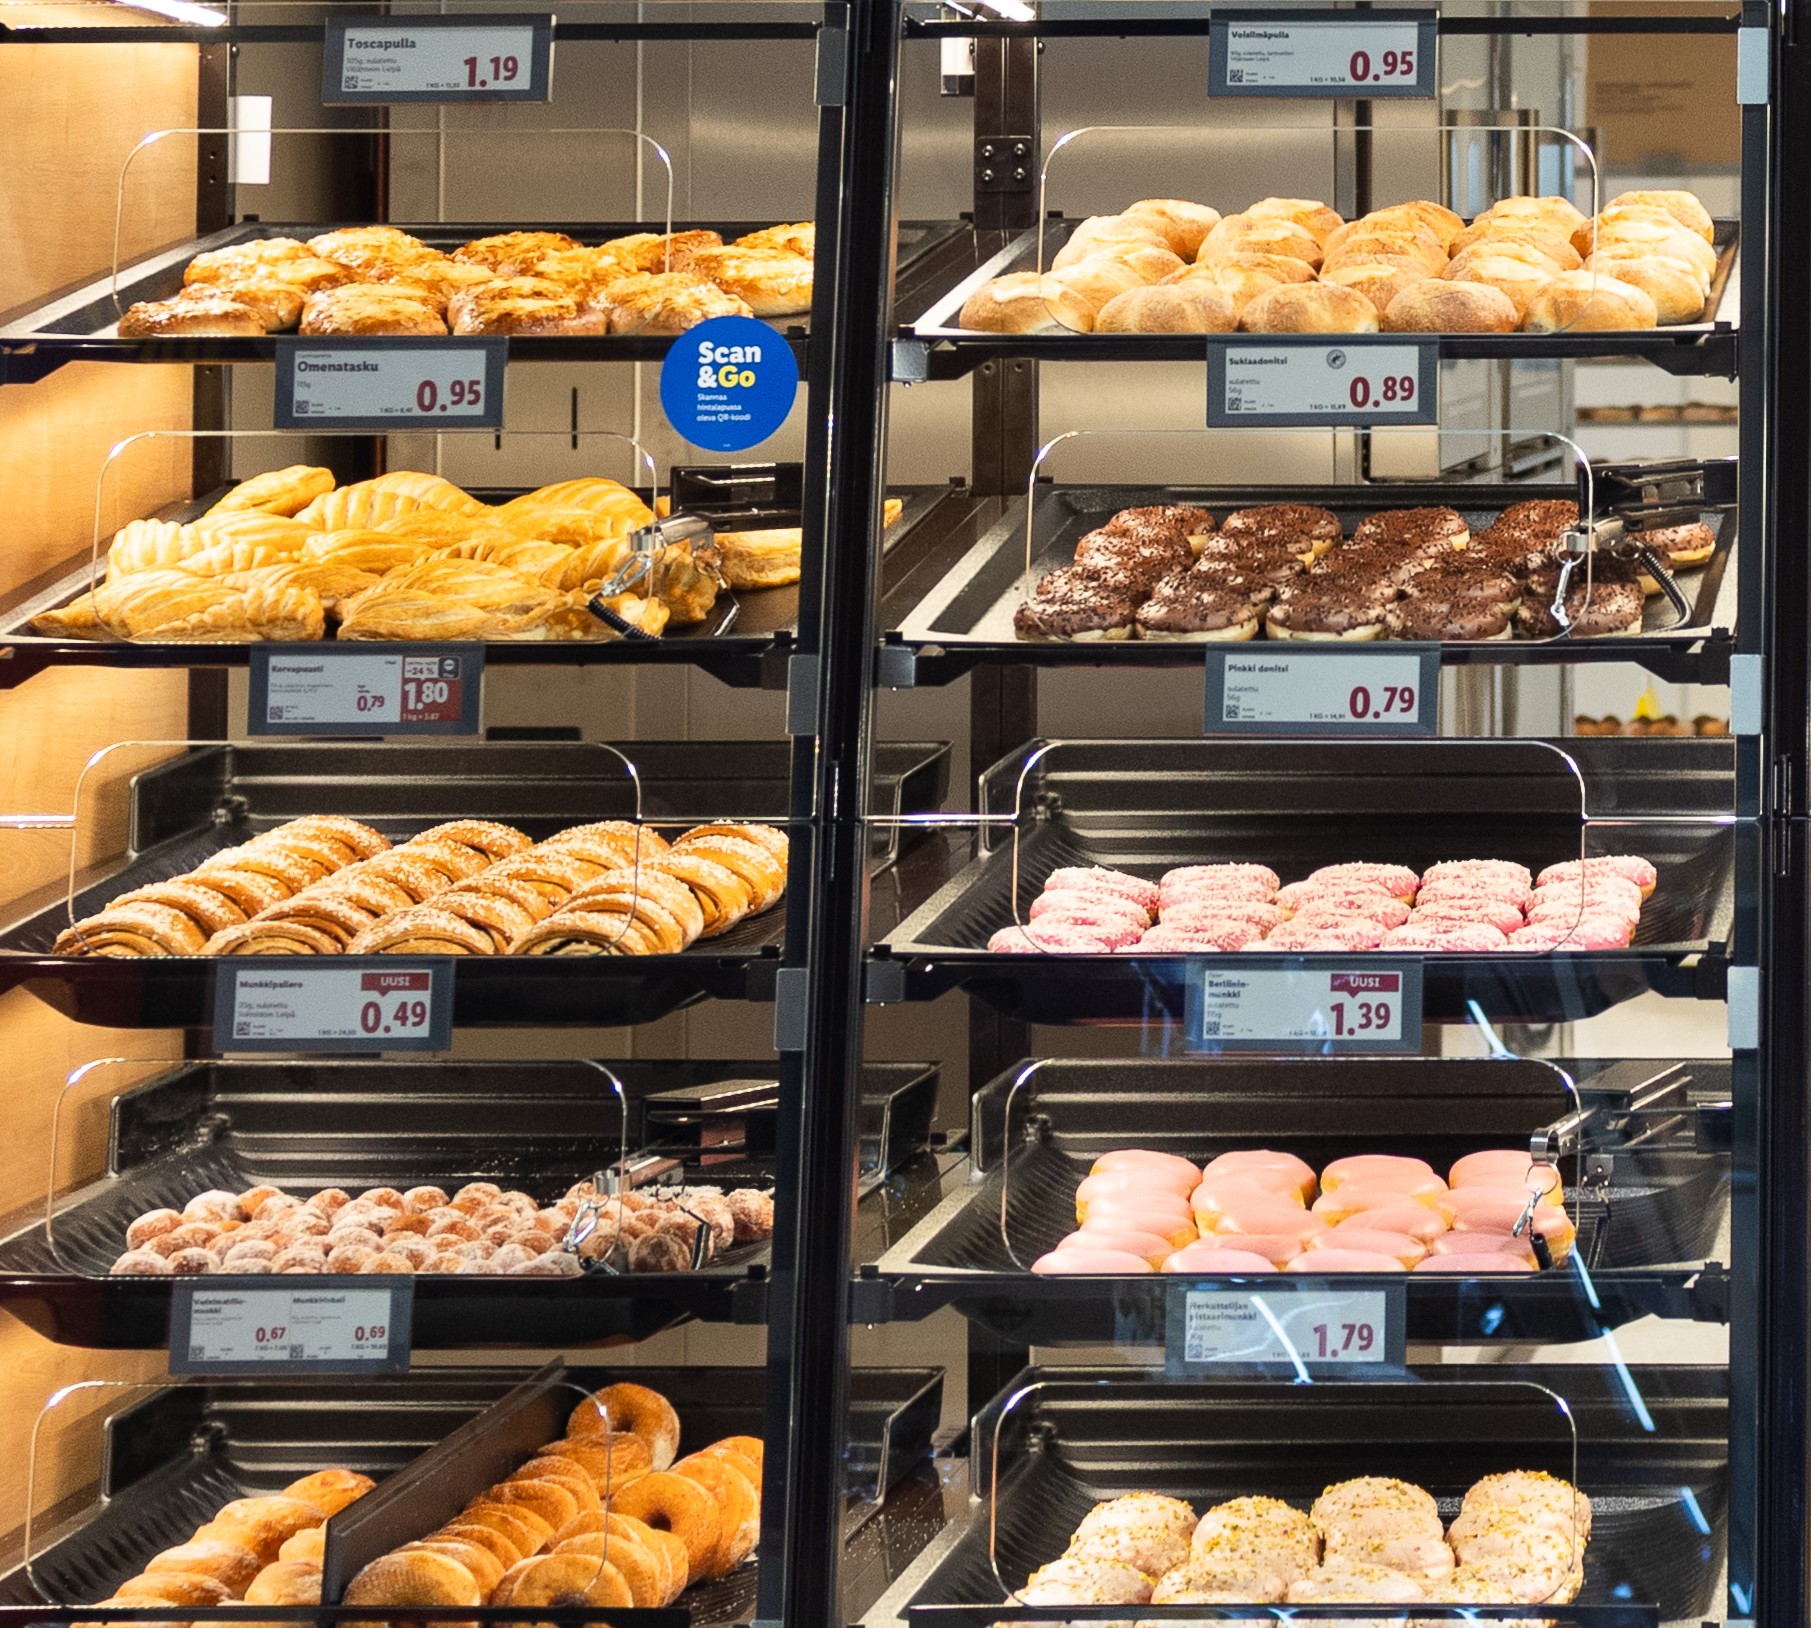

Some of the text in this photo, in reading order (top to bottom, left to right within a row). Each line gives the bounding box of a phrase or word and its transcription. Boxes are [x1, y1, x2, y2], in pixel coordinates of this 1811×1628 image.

[347, 38, 416, 50] Toscapulla
[463, 55, 519, 88] 1.19
[1350, 50, 1414, 82] 0.95
[697, 341, 762, 364] Scan
[1229, 356, 1288, 366] Suklaadonitsi
[297, 361, 379, 372] Omenatasku
[697, 365, 756, 388] &Go
[416, 379, 481, 412] 0.95
[1350, 376, 1415, 408] 0.89
[271, 664, 324, 675] Korvapuusti
[1228, 664, 1289, 673] Pinkki donitsi
[356, 695, 385, 712] 0.79
[404, 681, 449, 710] 1.80
[1349, 686, 1415, 720] 0.79
[239, 980, 303, 991] Munkkipallero
[380, 976, 410, 987] UUSI
[1350, 976, 1380, 987] UUSI
[361, 1001, 426, 1034] 0.49
[1330, 1002, 1391, 1036] 1.39
[255, 1327, 286, 1343] 0.67
[354, 1325, 386, 1341] 0.69
[1313, 1323, 1374, 1358] 1.79
